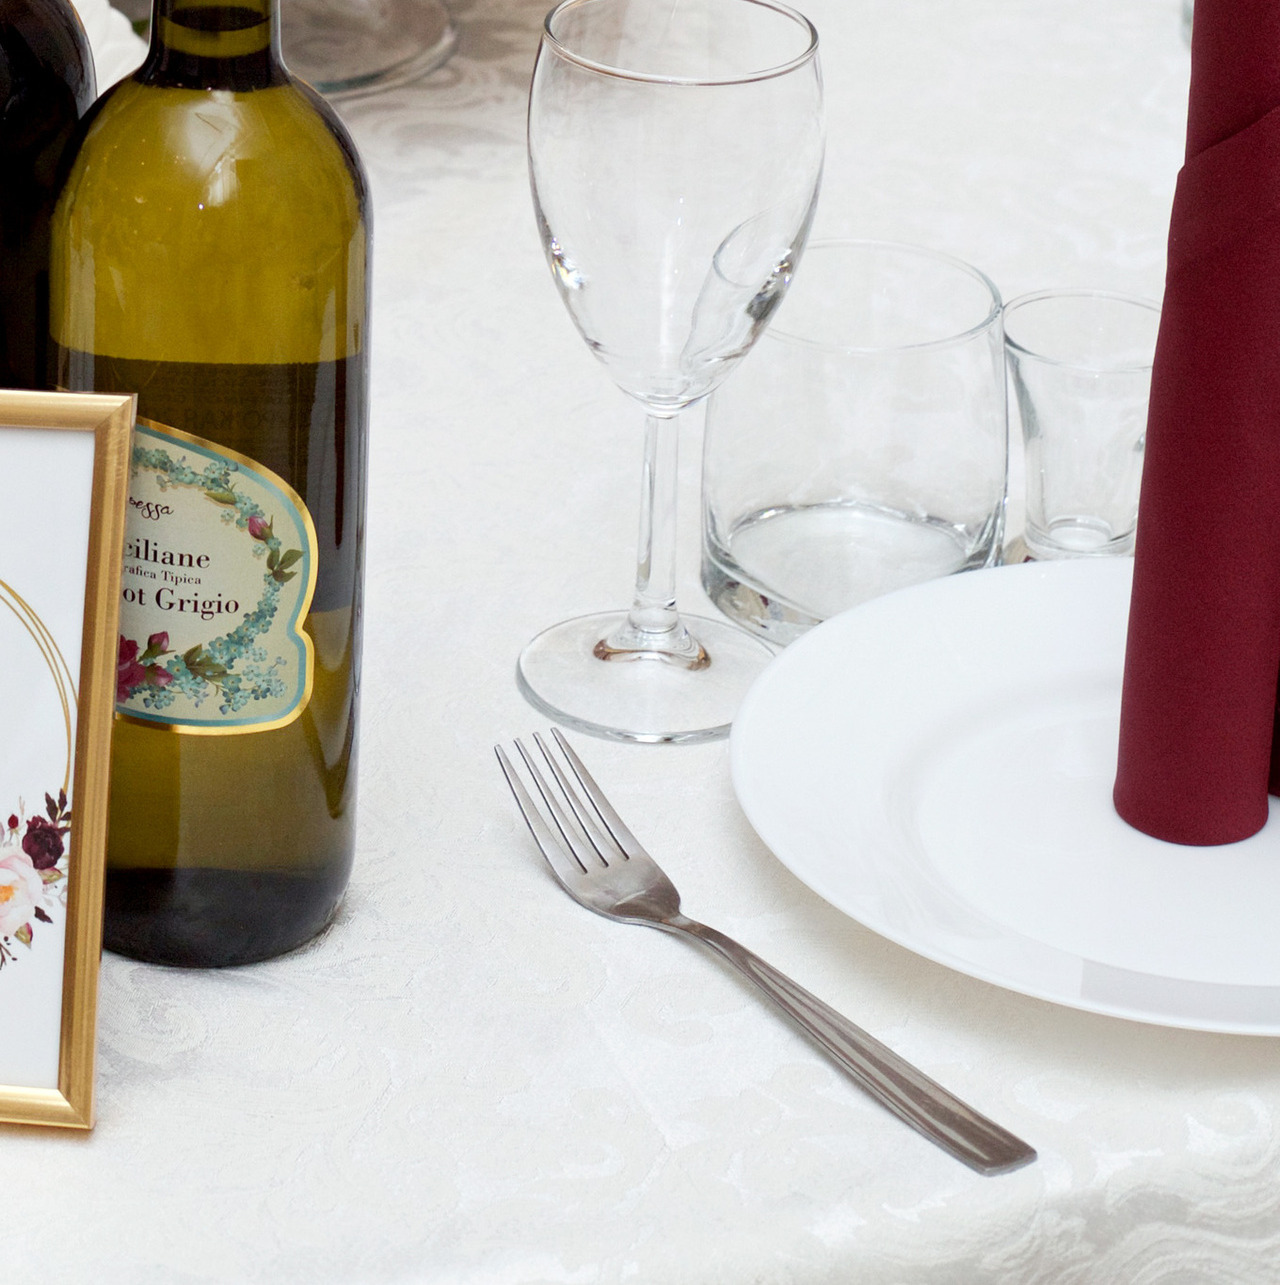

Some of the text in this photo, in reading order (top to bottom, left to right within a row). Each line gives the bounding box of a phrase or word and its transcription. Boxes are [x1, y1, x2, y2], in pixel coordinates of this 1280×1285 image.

[125, 538, 210, 569] ciliane
[124, 565, 201, 586] rafica Tipica
[122, 587, 239, 621] ot Grigio
